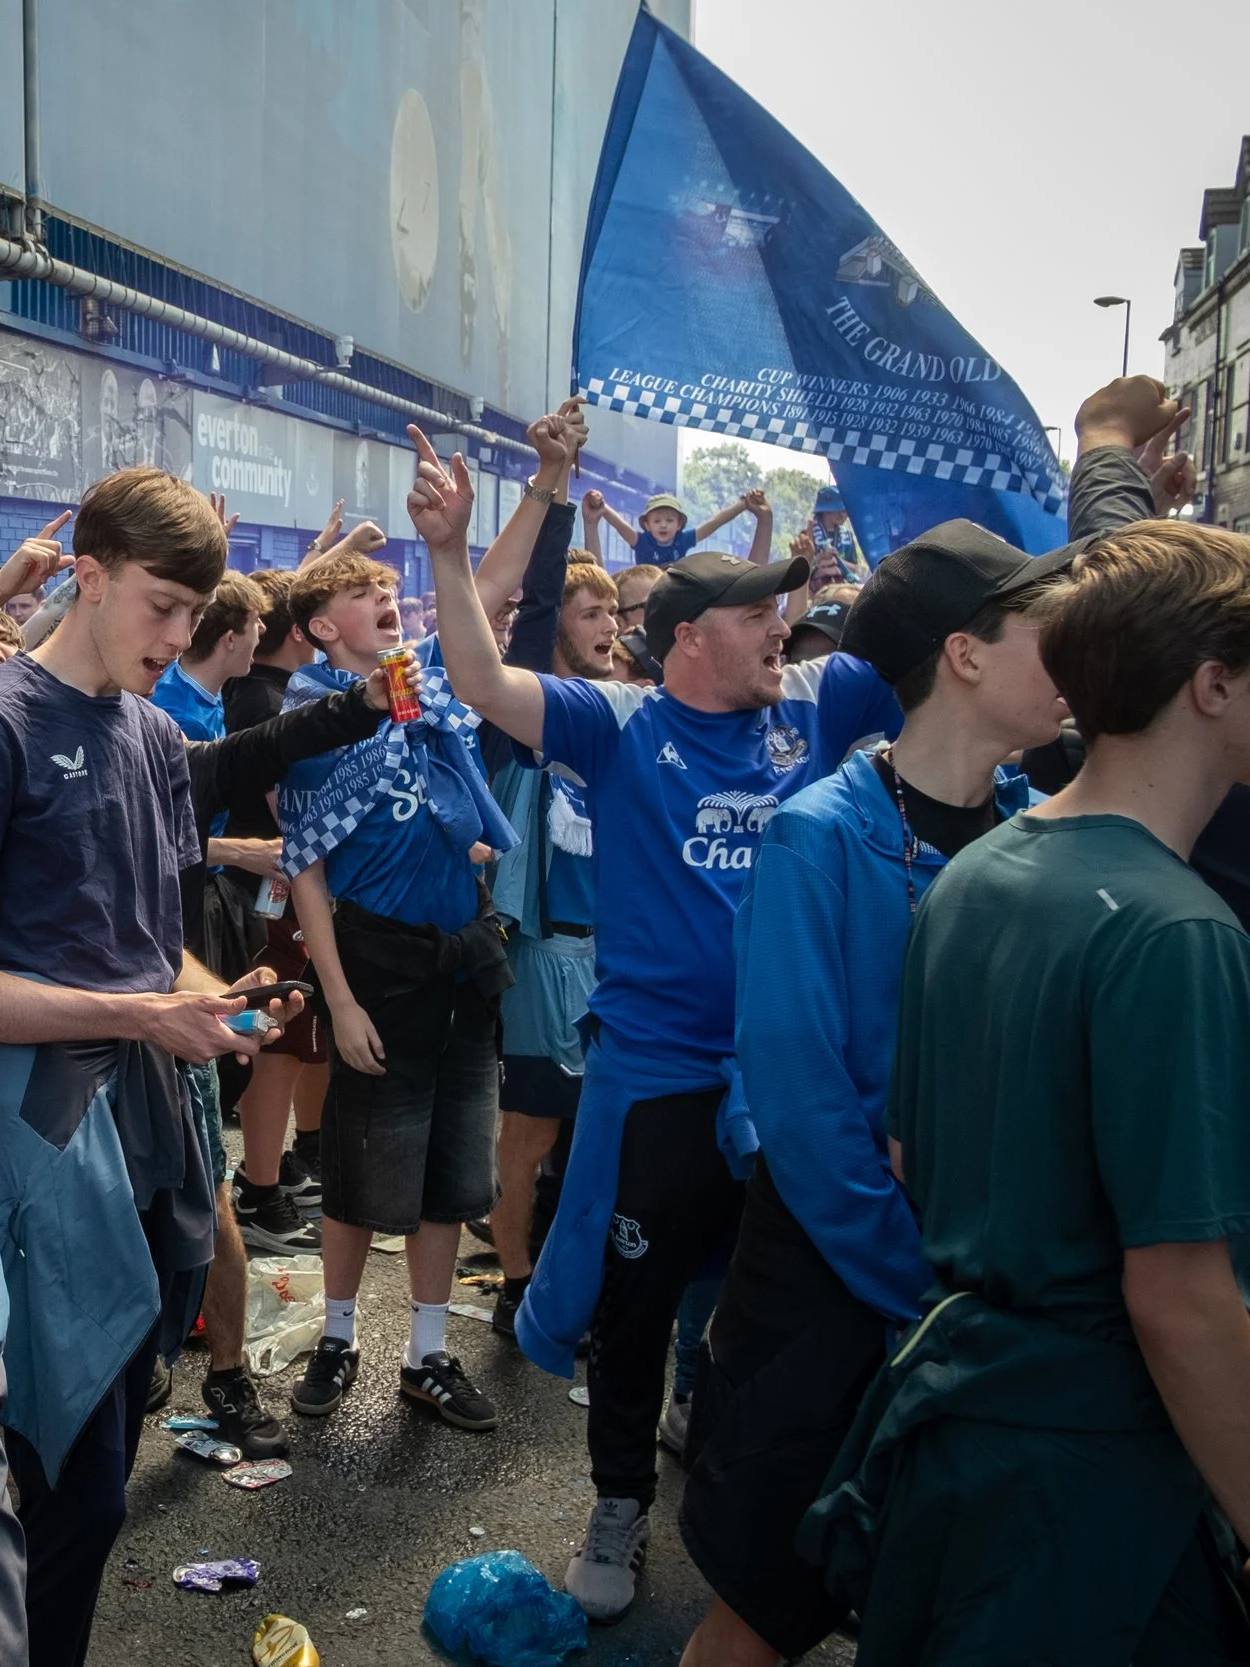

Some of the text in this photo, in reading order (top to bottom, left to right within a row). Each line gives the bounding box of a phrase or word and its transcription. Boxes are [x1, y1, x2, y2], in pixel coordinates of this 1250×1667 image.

[825, 296, 1001, 384] THE GRAND OLD
[608, 367, 679, 394] LEAGUE
[679, 384, 782, 416] CHAMPIONS
[781, 403, 809, 420] 1891
[810, 408, 839, 425] 1915
[839, 412, 868, 429] 1928
[868, 417, 899, 434] 1932
[900, 421, 931, 439] 1939
[931, 426, 965, 445] 1963
[701, 372, 776, 399] CHARITY
[777, 386, 839, 409] SHIELD
[839, 396, 870, 413] 1928
[870, 400, 899, 417] 1932
[900, 404, 931, 422] 1963
[932, 409, 964, 428] 1970
[757, 367, 794, 386] CUP
[795, 373, 872, 397] WINNERS
[873, 384, 910, 402] 1906
[910, 388, 949, 407] 1933
[979, 404, 1015, 426] 1984
[197, 412, 258, 457] everton
[212, 455, 292, 508] community
[319, 789, 344, 814] 1970
[344, 771, 371, 797] 1985
[333, 759, 359, 785] 1985
[682, 836, 753, 870] Cha
